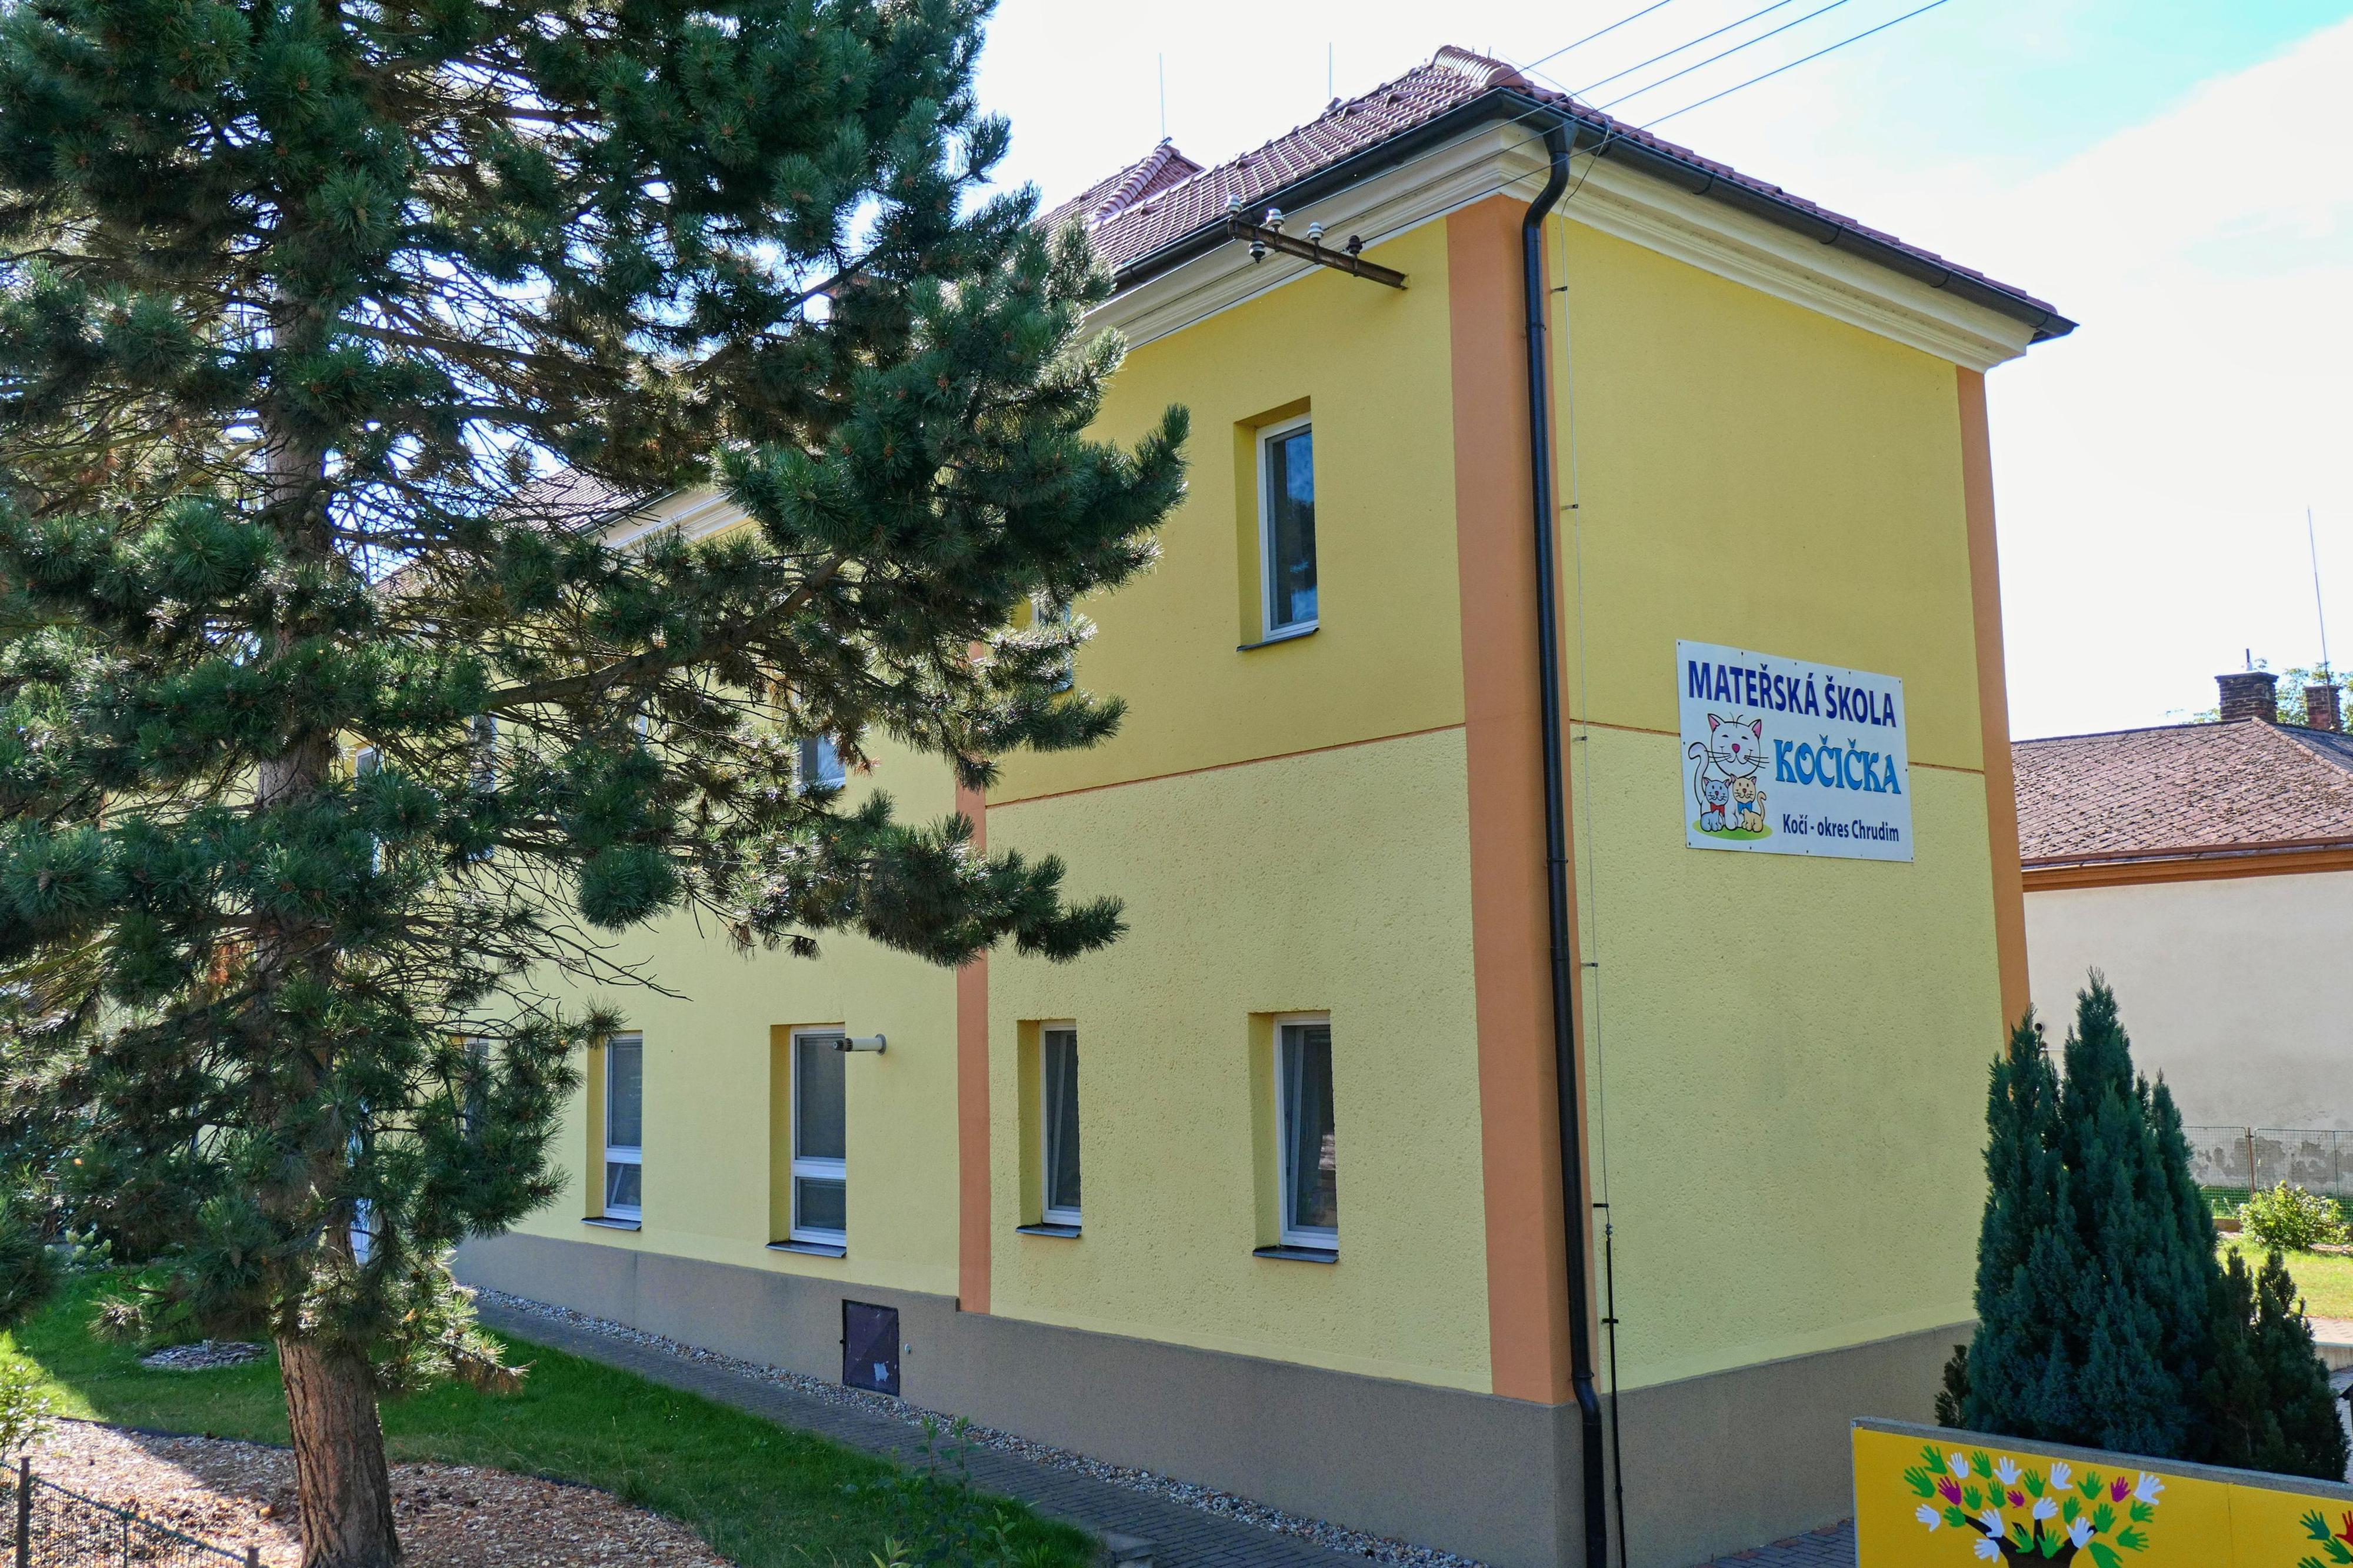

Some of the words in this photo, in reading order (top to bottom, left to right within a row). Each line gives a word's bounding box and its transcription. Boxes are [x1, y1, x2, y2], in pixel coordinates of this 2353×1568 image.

[1688, 660, 1819, 717] MATEŘSKÁ
[1825, 675, 1897, 728] ŠKOLA
[1773, 733, 1902, 795] KOČIČKA
[1782, 813, 1809, 835] Kočí
[1817, 818, 1849, 838] okres
[1852, 819, 1899, 842] Chrudim
